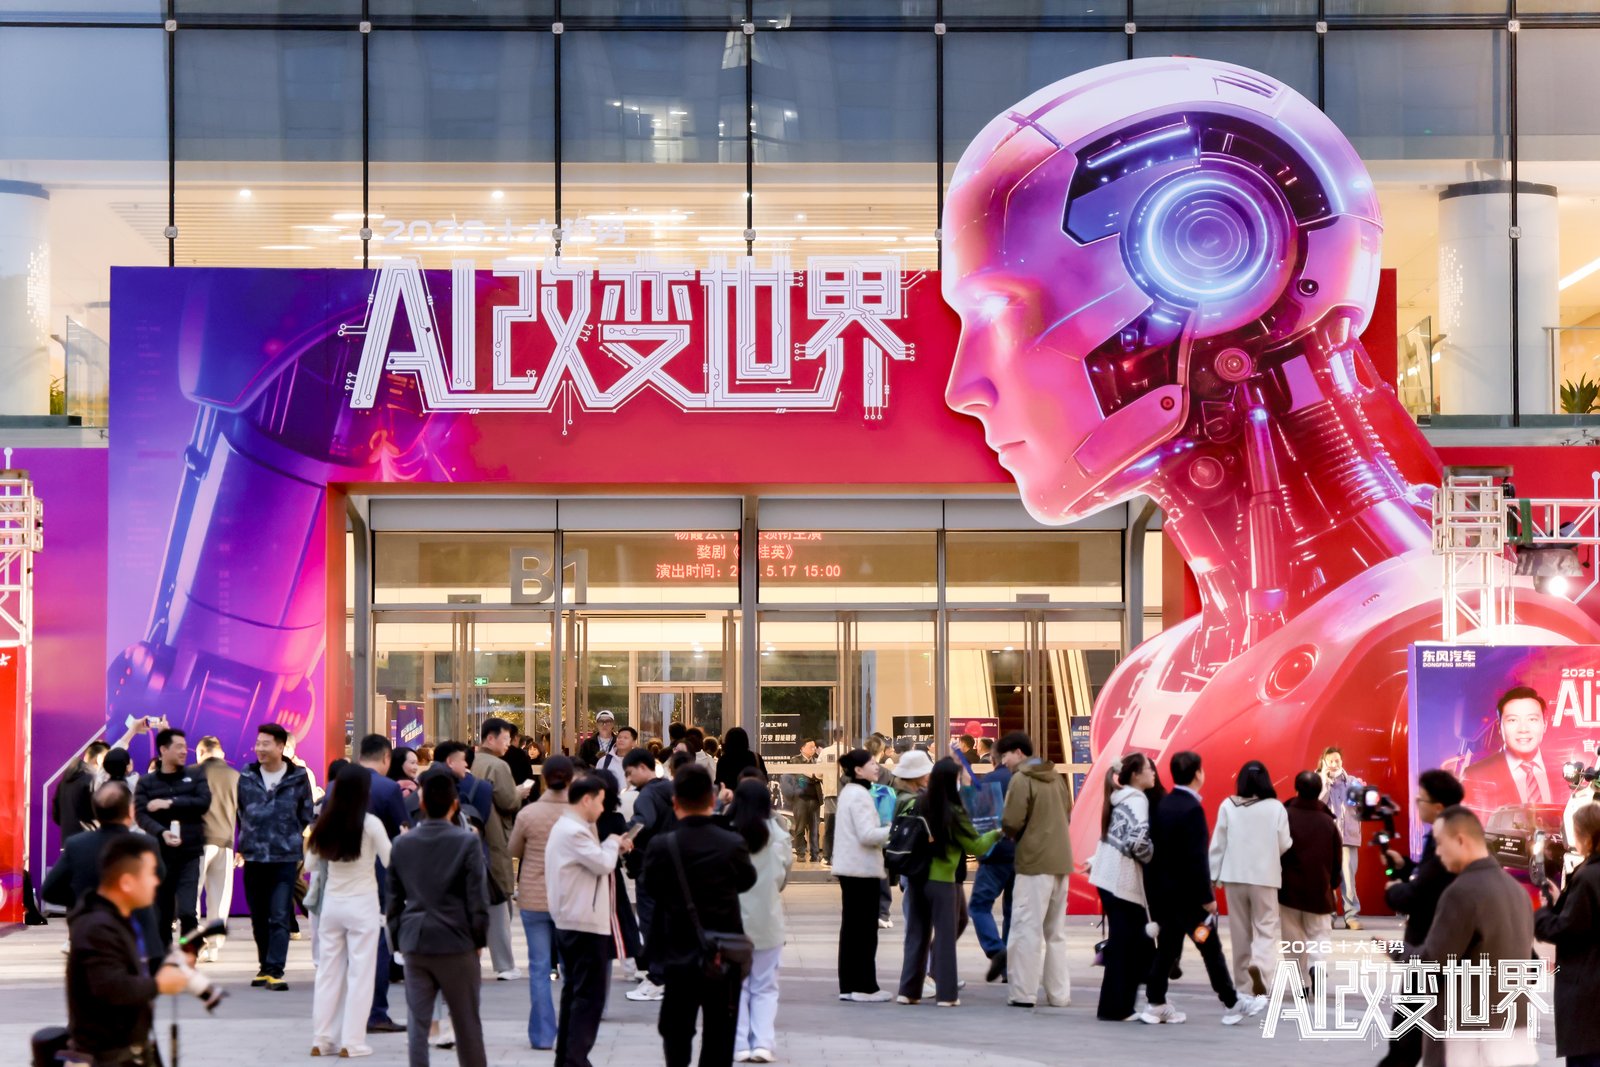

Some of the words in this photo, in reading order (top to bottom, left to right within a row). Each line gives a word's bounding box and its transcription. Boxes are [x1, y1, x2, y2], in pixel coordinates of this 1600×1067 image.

[340, 252, 918, 415] AI改变世界
[696, 544, 794, 560] 婺剧《桂英》
[510, 547, 588, 604] B1
[803, 564, 841, 577] 15:00
[1422, 650, 1476, 662] 东风汽车
[1561, 668, 1595, 678] 2026
[1550, 679, 1600, 728] AI
